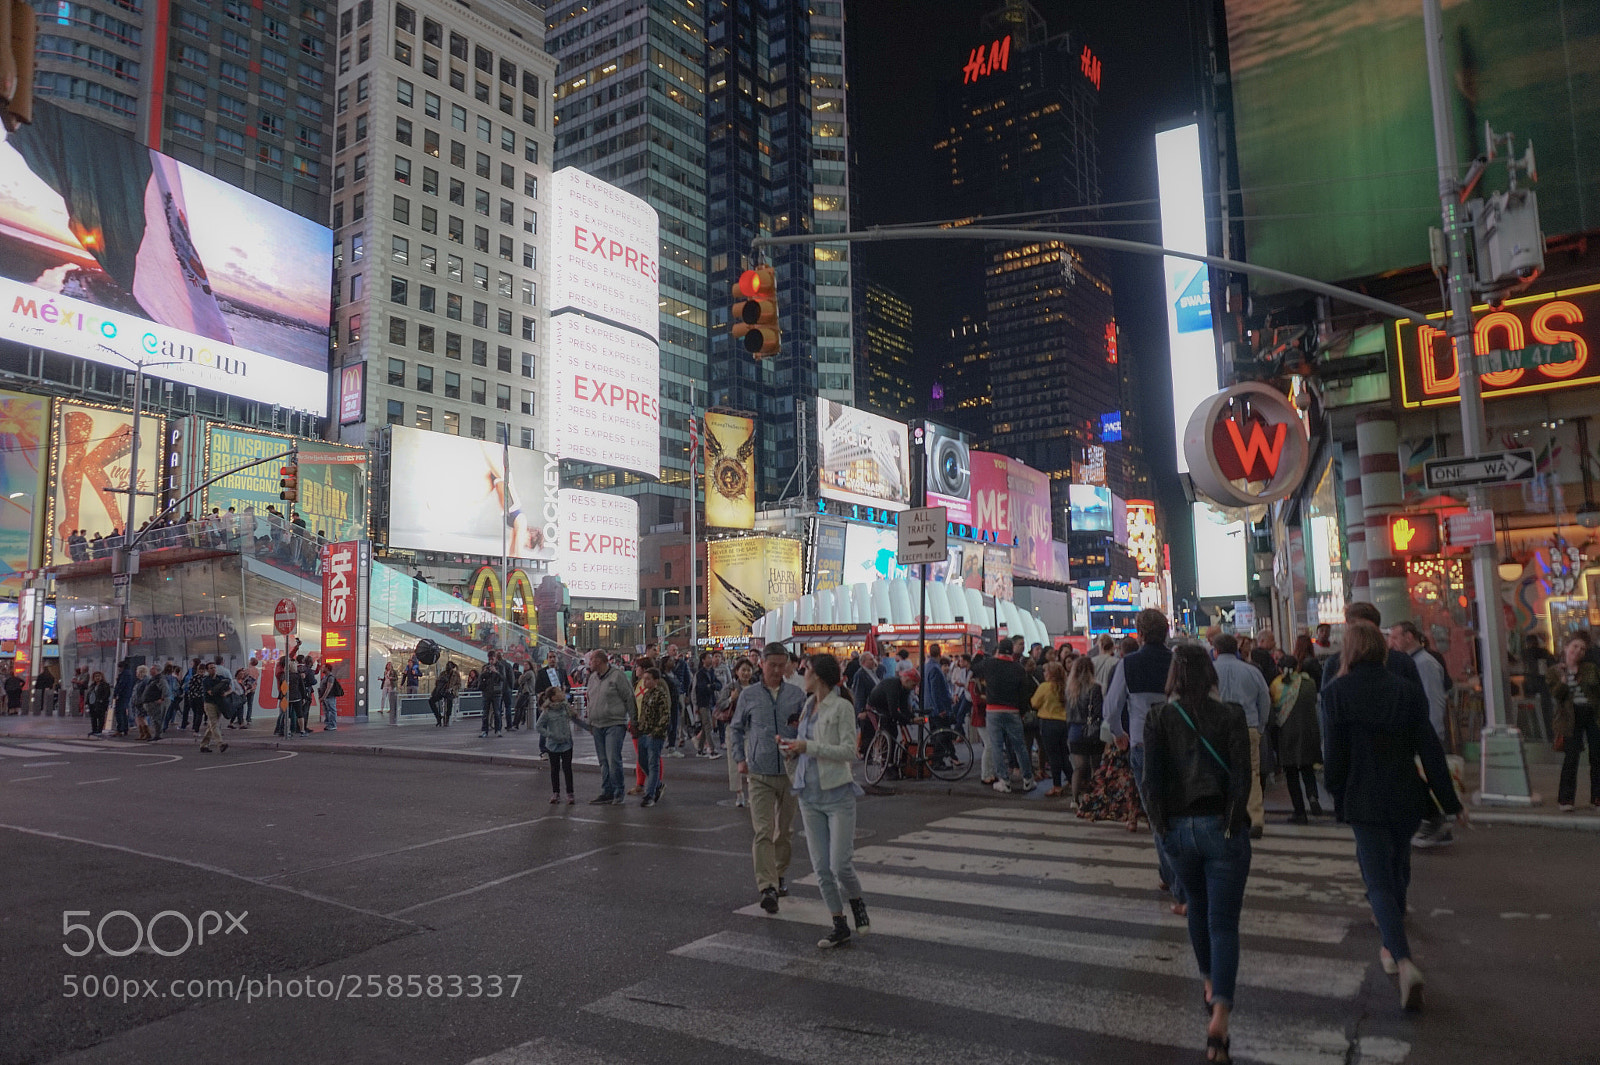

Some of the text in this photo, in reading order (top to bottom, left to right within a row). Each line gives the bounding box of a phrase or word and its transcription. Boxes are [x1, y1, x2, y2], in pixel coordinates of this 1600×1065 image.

[575, 225, 658, 284] EXPRES
[1505, 350, 1522, 369] W
[1532, 345, 1553, 364] 47
[575, 375, 659, 421] EXPRES
[213, 434, 287, 461] AN INSPIRED
[1226, 418, 1287, 478] W
[212, 452, 287, 480] BROADWAY
[325, 464, 332, 485] A
[1435, 461, 1518, 480] ONE WAY
[211, 473, 283, 494] EXTRAVAGANZA
[302, 478, 348, 520] BRONX
[543, 453, 559, 560] JOCKEY
[914, 512, 930, 522] ALL
[907, 523, 937, 534] TRAFFIC
[947, 522, 999, 543] ADWAY
[569, 531, 638, 559] EXPRES
[330, 549, 352, 623] tkts
[768, 580, 800, 595] POTTER
[769, 568, 796, 587] HARRY
[584, 612, 618, 622] EXPRESS
[720, 636, 750, 645] LUGGAGE
